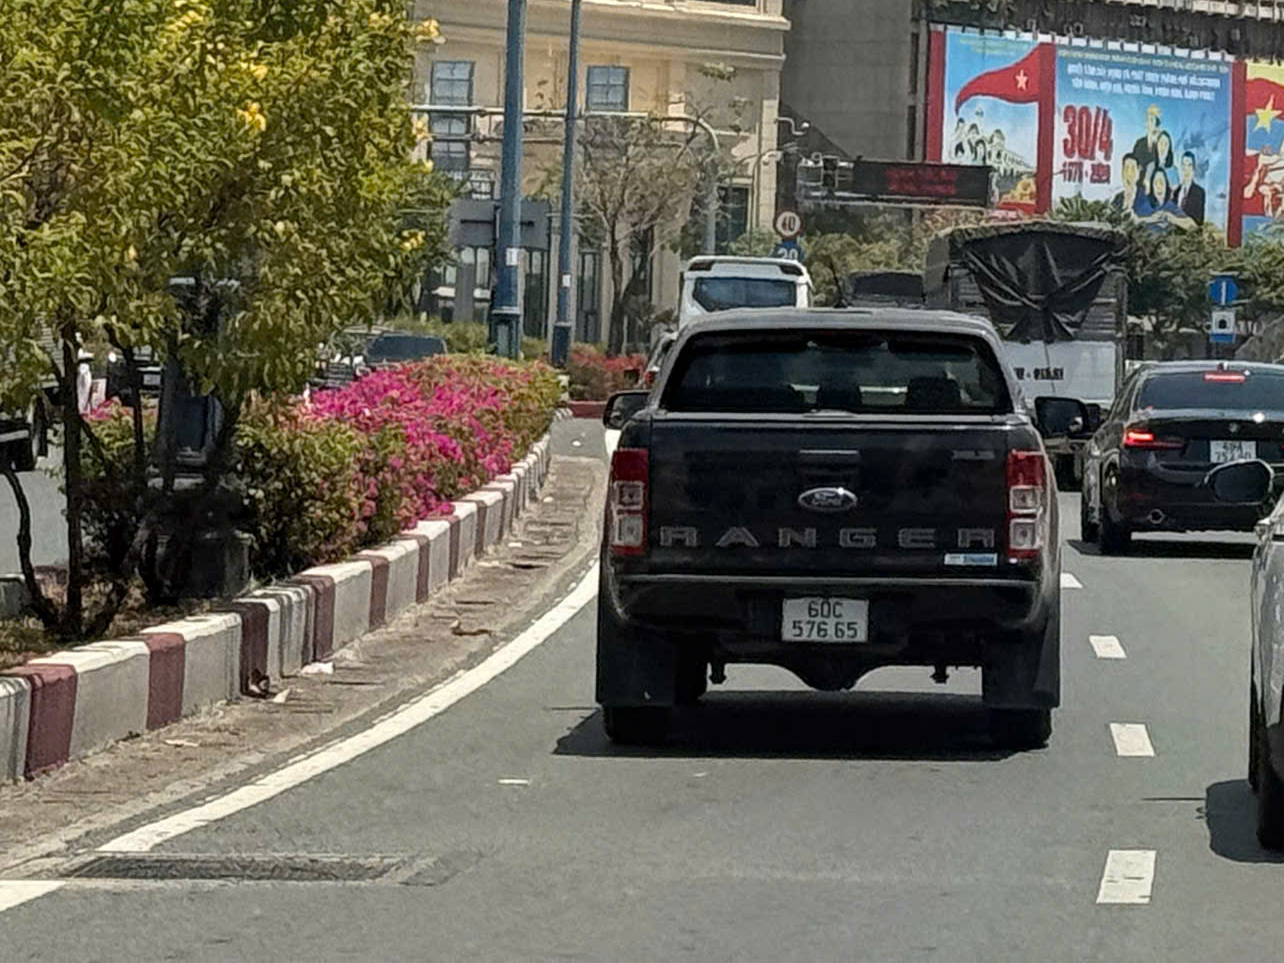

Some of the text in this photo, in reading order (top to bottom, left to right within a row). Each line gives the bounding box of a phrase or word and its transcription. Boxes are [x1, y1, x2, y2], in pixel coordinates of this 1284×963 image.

[1062, 104, 1113, 161] 30/4
[781, 216, 796, 231] 40
[660, 526, 995, 548] RANGER
[808, 601, 843, 619] 60C
